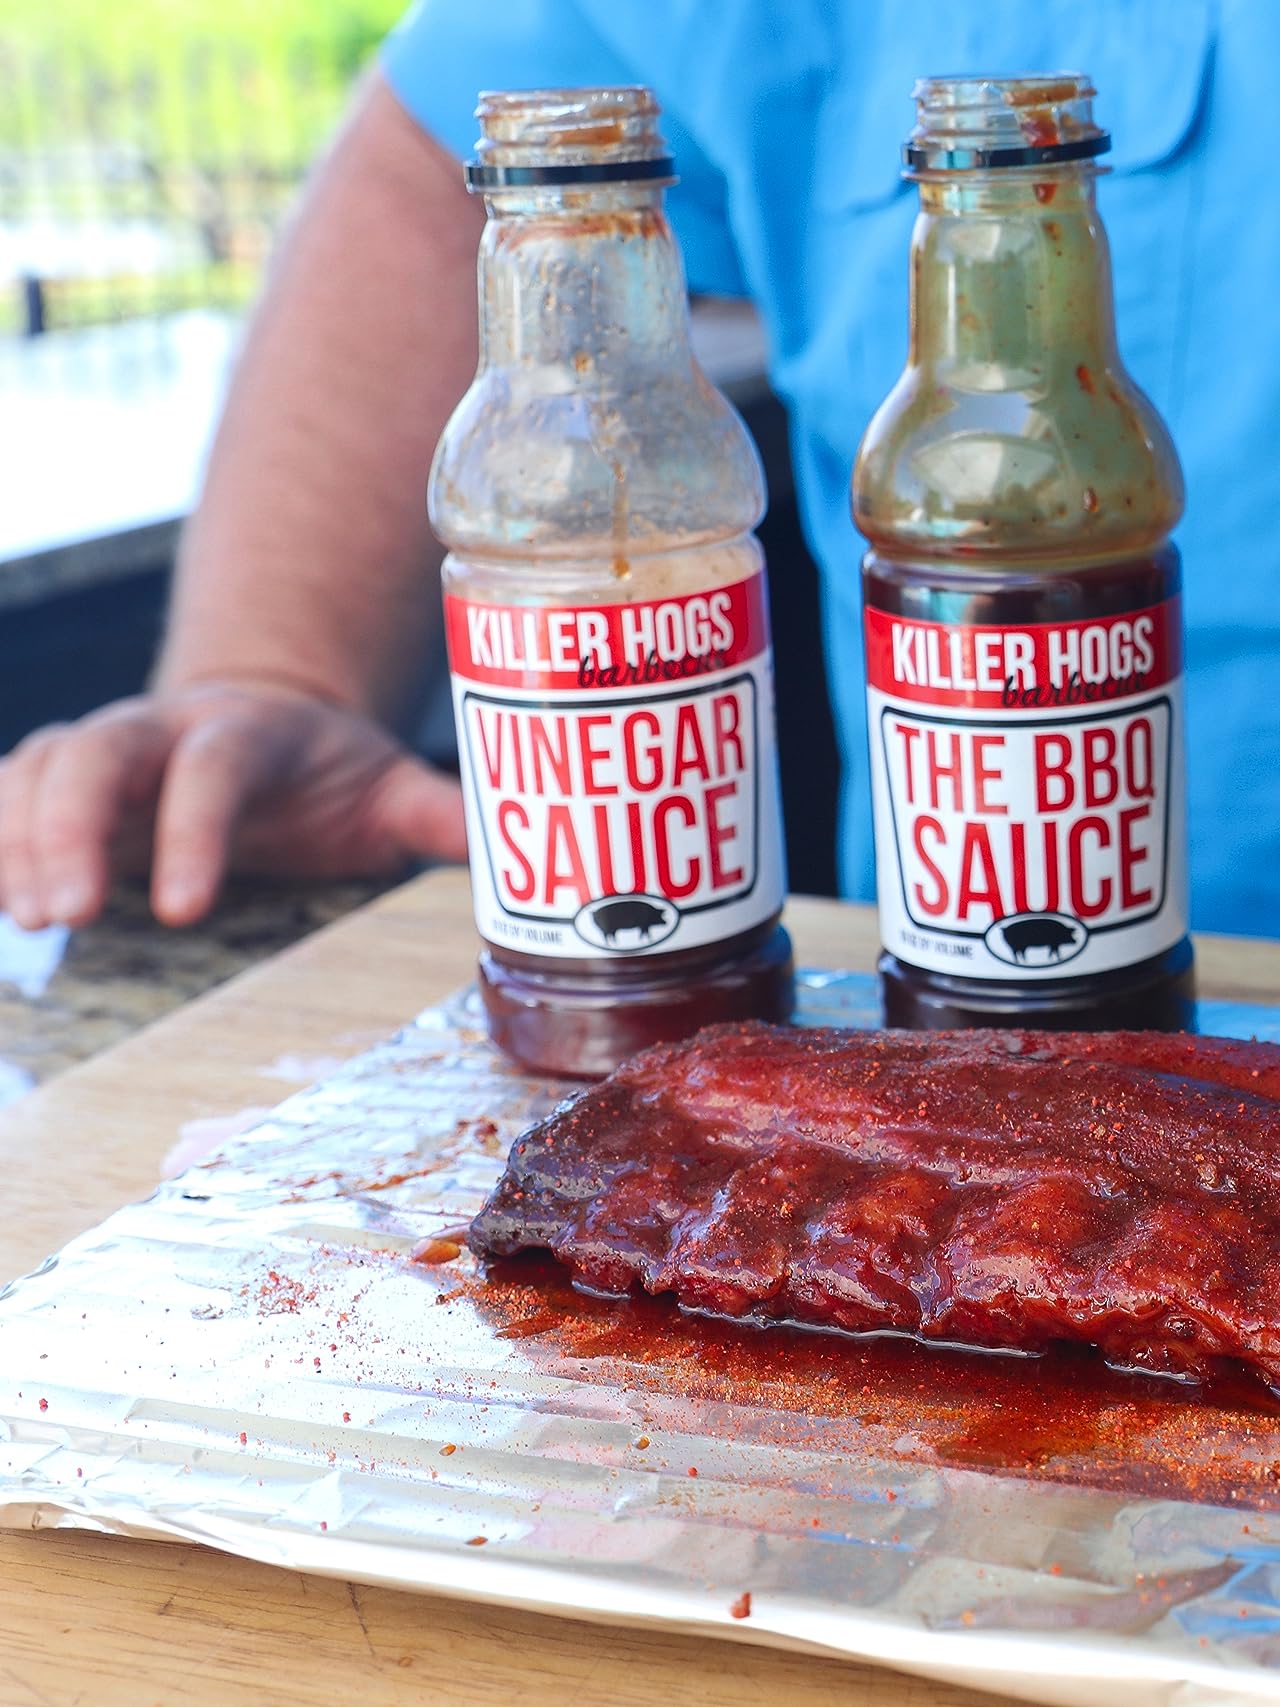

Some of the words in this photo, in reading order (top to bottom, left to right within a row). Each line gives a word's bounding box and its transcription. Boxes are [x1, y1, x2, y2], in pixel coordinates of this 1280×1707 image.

[467, 606, 610, 671] KILLER
[621, 593, 733, 662] HOGS
[893, 623, 1036, 691] KILLER
[1048, 616, 1154, 689] HOGS
[477, 694, 744, 796] VINEGAR
[895, 723, 1008, 814] THE
[1034, 718, 1155, 814] BBQ
[498, 782, 743, 905] SAUCE
[914, 804, 1152, 921] SAUCE
